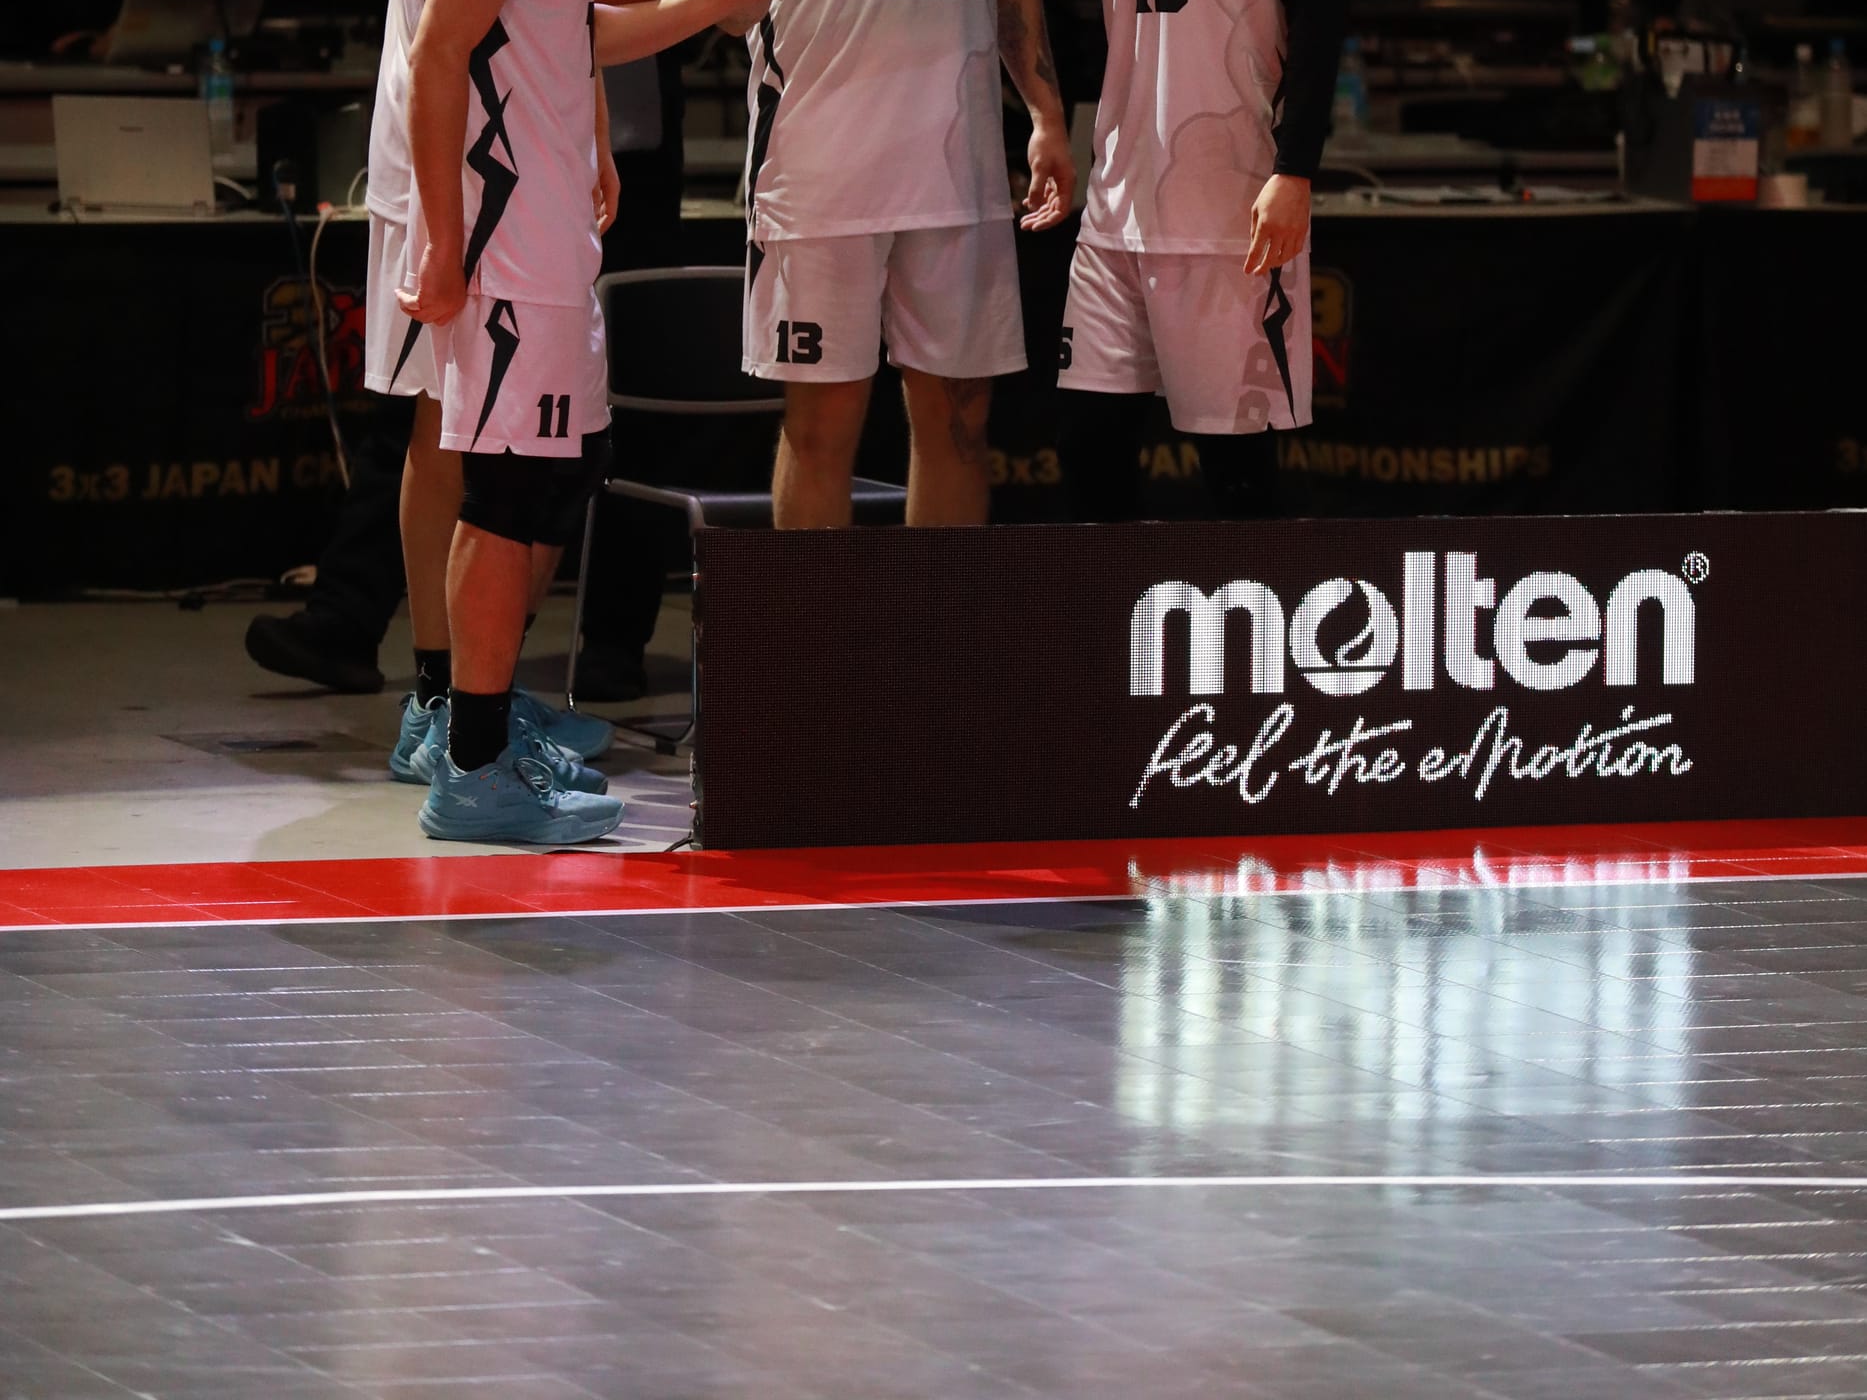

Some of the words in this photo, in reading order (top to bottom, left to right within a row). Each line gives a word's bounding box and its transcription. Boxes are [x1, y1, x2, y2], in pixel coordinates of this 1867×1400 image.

[776, 320, 822, 364] 13
[537, 394, 570, 438] 11
[141, 456, 281, 498] JAPAN
[1128, 702, 1295, 809] feel
[1288, 714, 1413, 797] the
